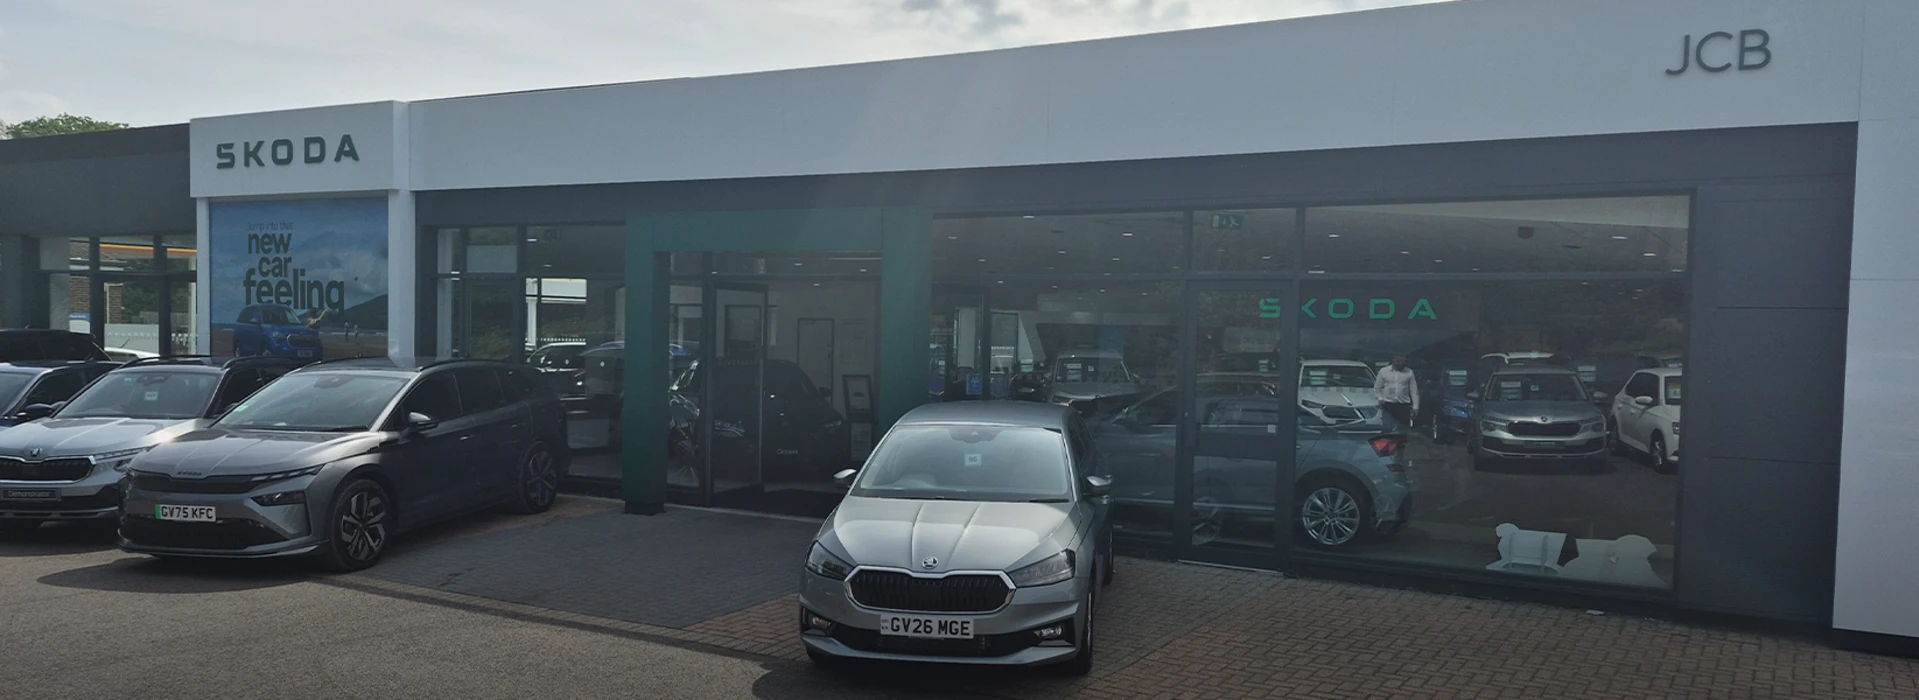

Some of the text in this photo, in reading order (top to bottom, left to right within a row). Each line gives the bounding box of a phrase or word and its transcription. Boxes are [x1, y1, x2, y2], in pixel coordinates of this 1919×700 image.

[1665, 28, 1772, 76] JCB
[216, 133, 360, 170] SKODA
[247, 232, 293, 255] new
[258, 256, 293, 278] car
[243, 267, 346, 316] feeling
[161, 506, 213, 519] GV75 KFC
[890, 616, 971, 636] GV26 MGE
